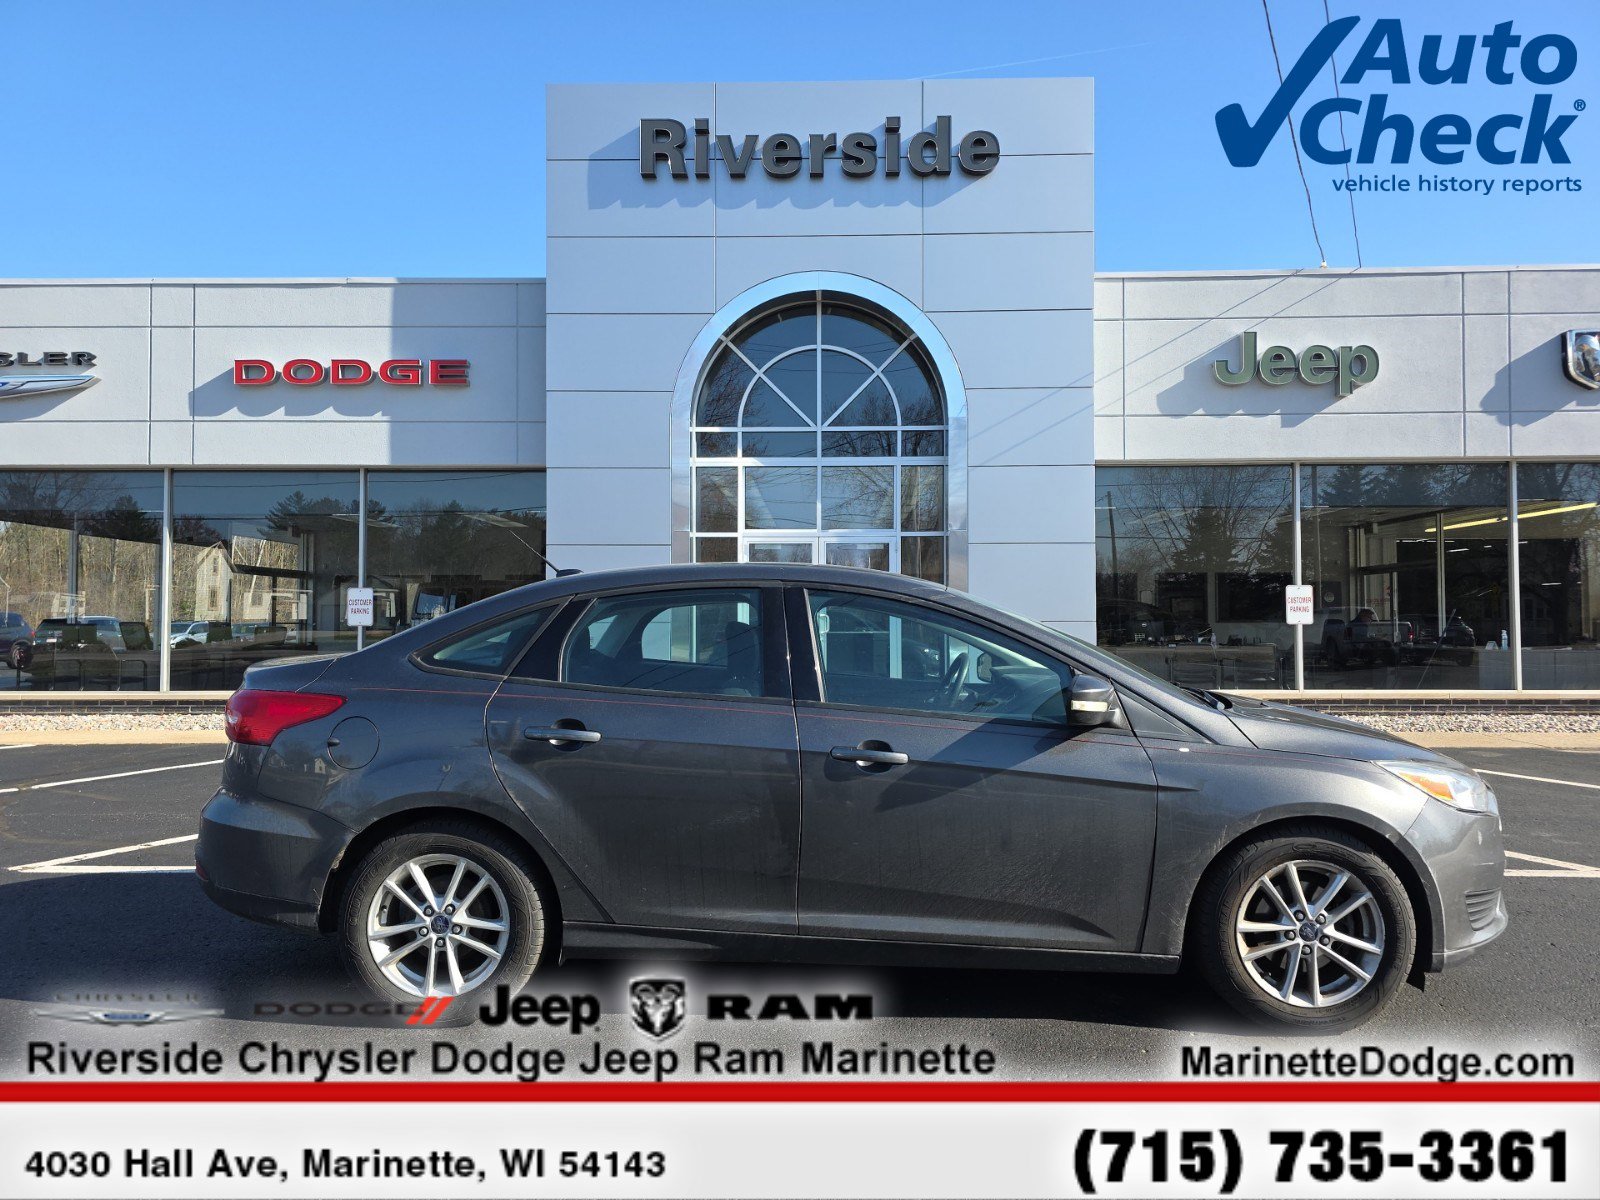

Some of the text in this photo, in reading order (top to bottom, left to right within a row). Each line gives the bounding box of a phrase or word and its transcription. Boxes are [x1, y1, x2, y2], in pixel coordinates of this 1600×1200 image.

[639, 115, 1001, 179] Riverside
[1213, 331, 1380, 397] Jeep
[233, 359, 470, 387] DODGE
[348, 598, 373, 606] CUSTOMER
[1287, 596, 1312, 604] CUSTOMER
[350, 607, 370, 615] PARKING
[1289, 605, 1310, 613] PARKING
